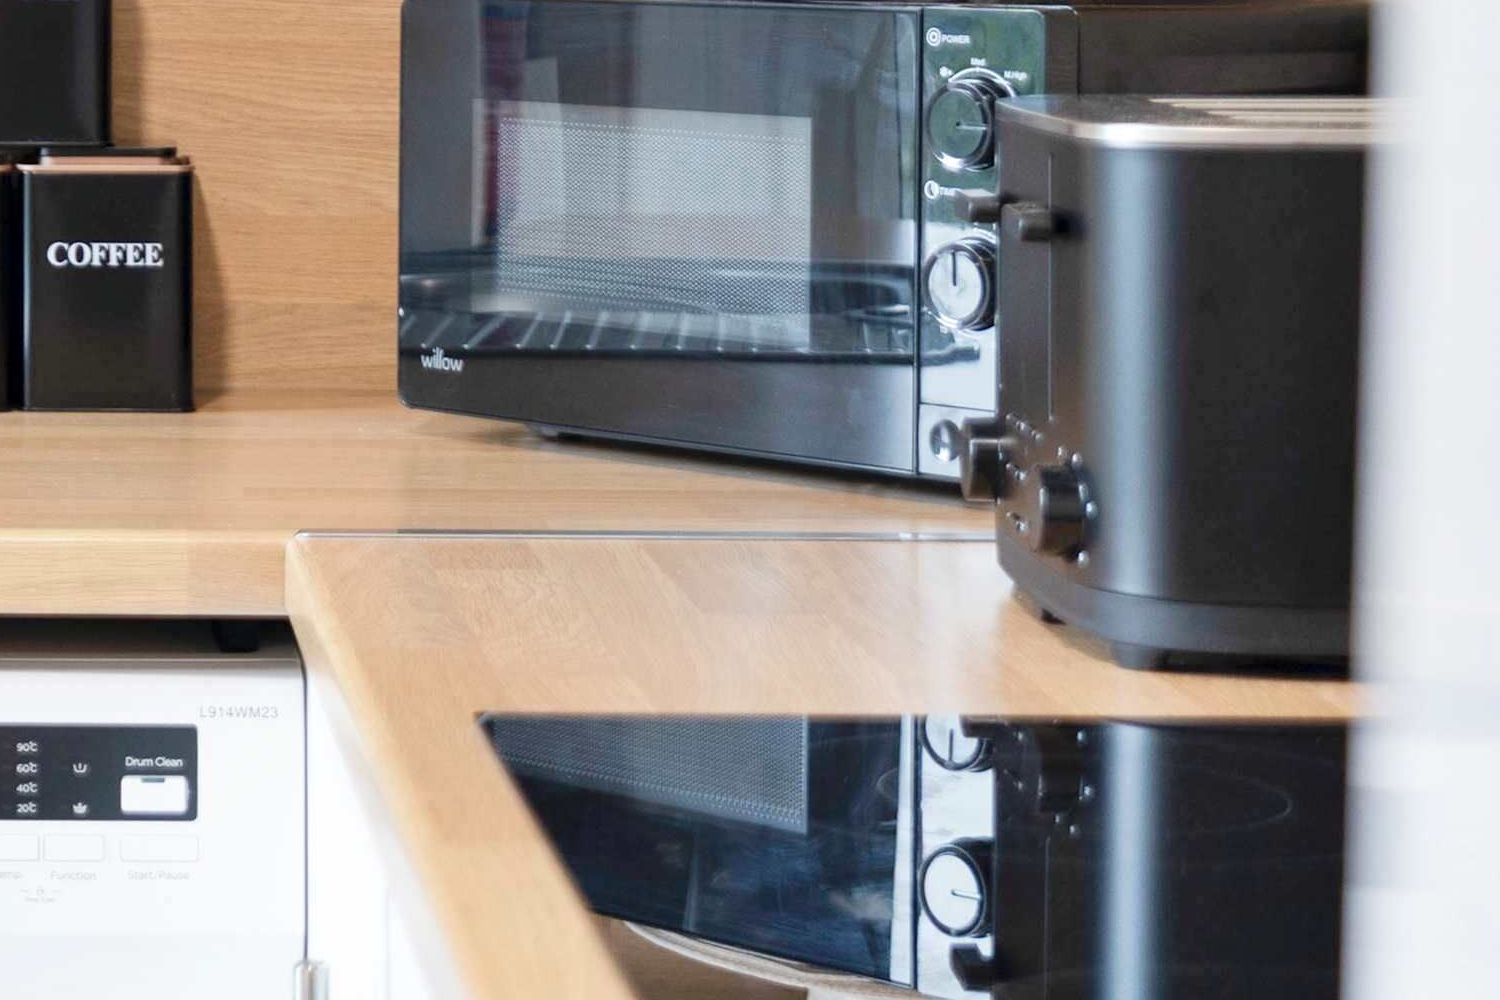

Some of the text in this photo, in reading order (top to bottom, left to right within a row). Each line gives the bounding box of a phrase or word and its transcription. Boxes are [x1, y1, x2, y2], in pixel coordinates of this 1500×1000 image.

[942, 34, 971, 44] POWER
[46, 242, 164, 267] COFFEE
[420, 347, 464, 372] willow
[199, 705, 279, 719] L914WM23
[125, 756, 184, 767] Drum Clean
[50, 871, 97, 881] Function
[127, 870, 190, 881] Start/Pause
